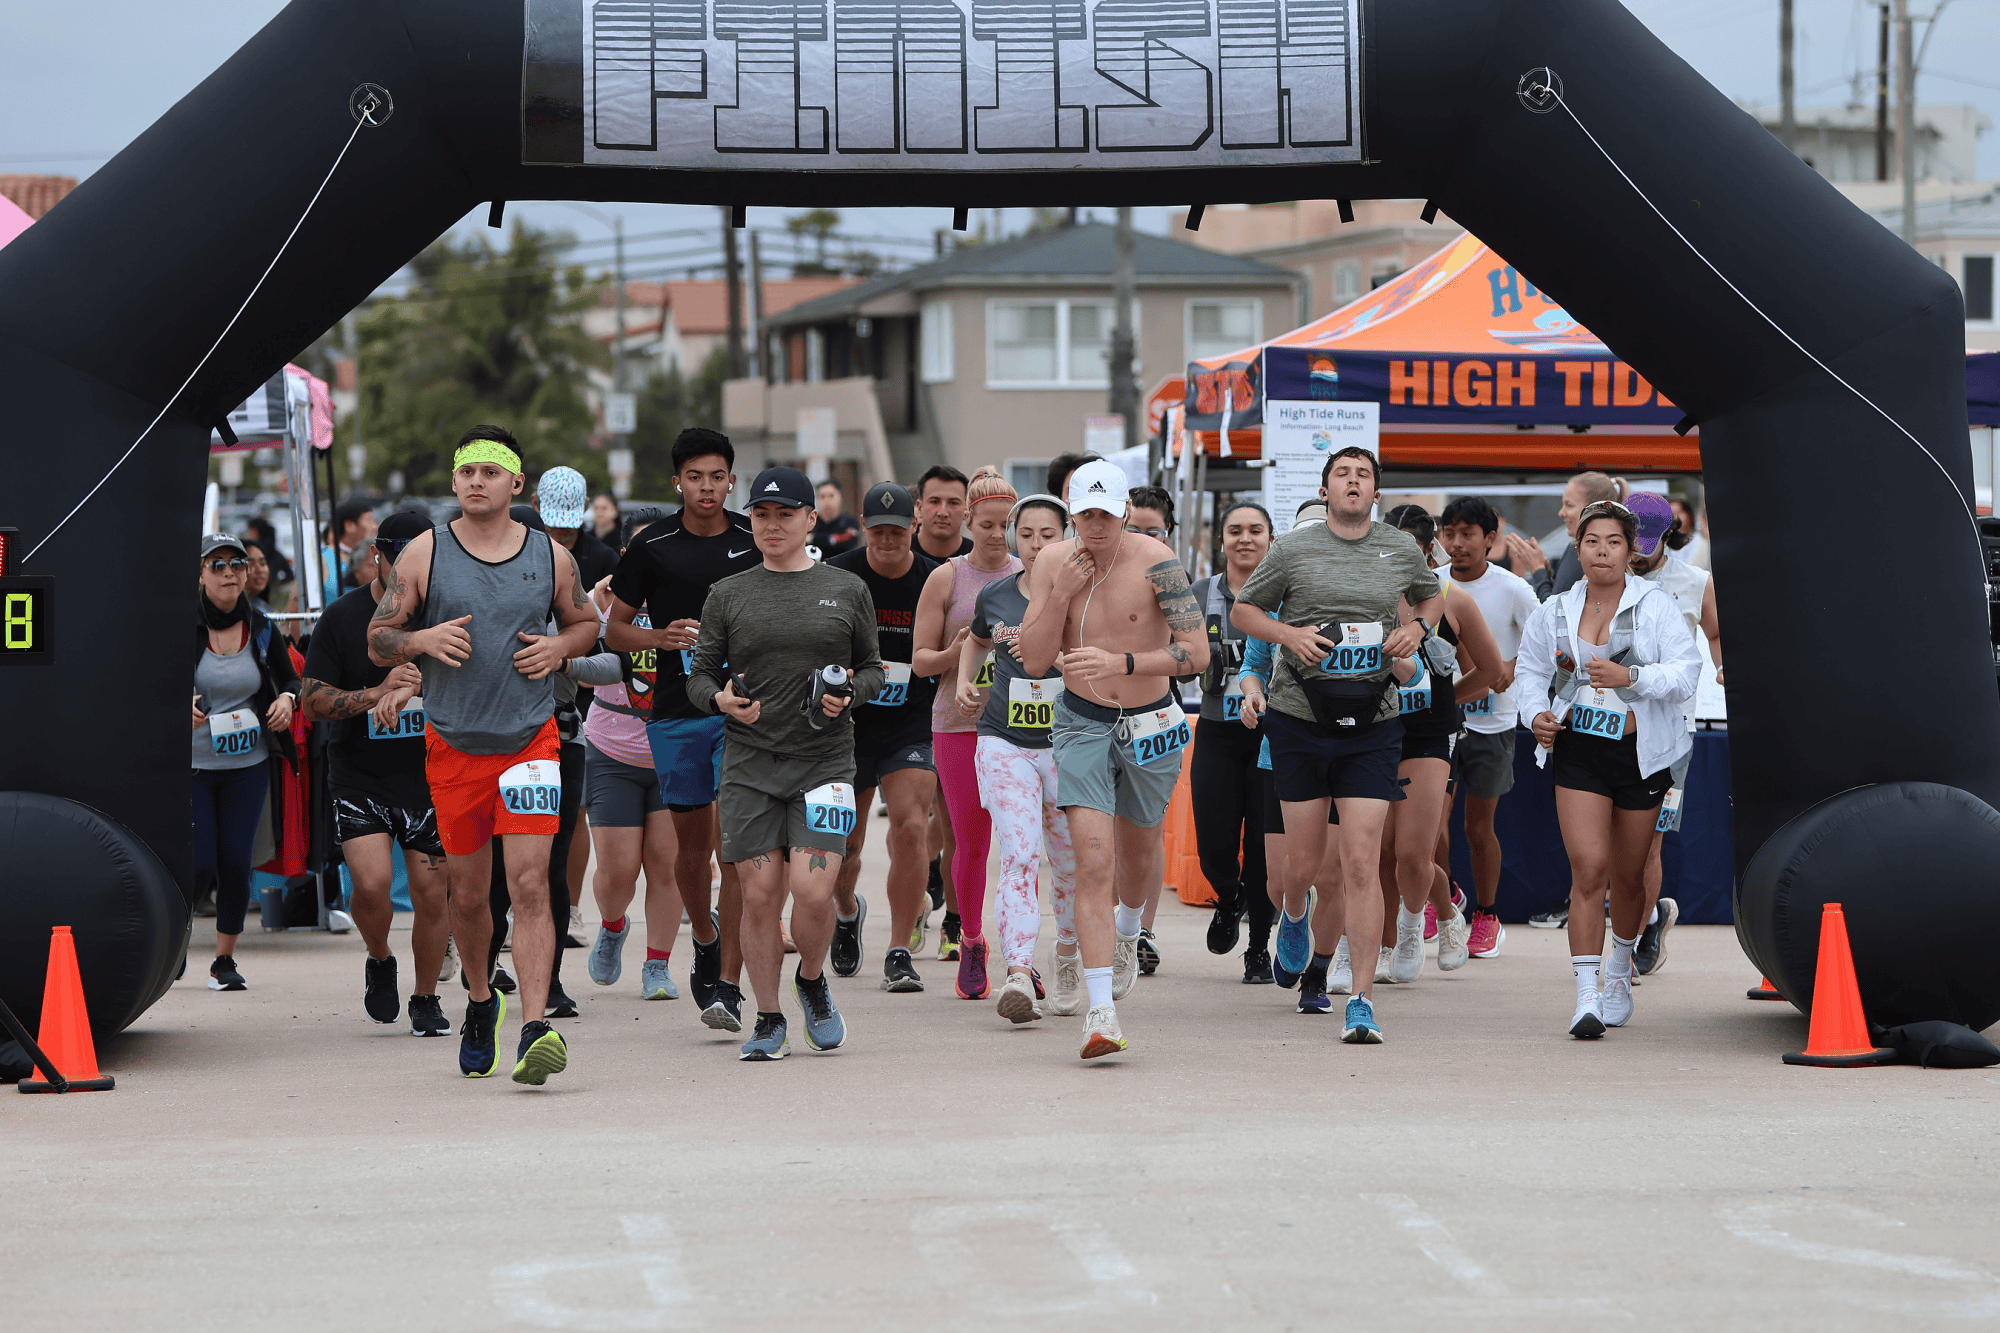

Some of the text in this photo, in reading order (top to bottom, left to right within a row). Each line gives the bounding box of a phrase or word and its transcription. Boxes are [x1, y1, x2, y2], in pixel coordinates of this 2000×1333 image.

[594, 0, 1352, 154] FINISH
[1389, 360, 1535, 406] HIGH
[1280, 408, 1365, 420] High Tide Runs
[1326, 647, 1378, 670] 2029
[1012, 703, 1054, 725] 260
[1574, 706, 1621, 735] 2028
[216, 729, 258, 753] 2020
[1138, 722, 1190, 761] 2026
[505, 786, 559, 811] 2030
[814, 805, 854, 833] 2017
